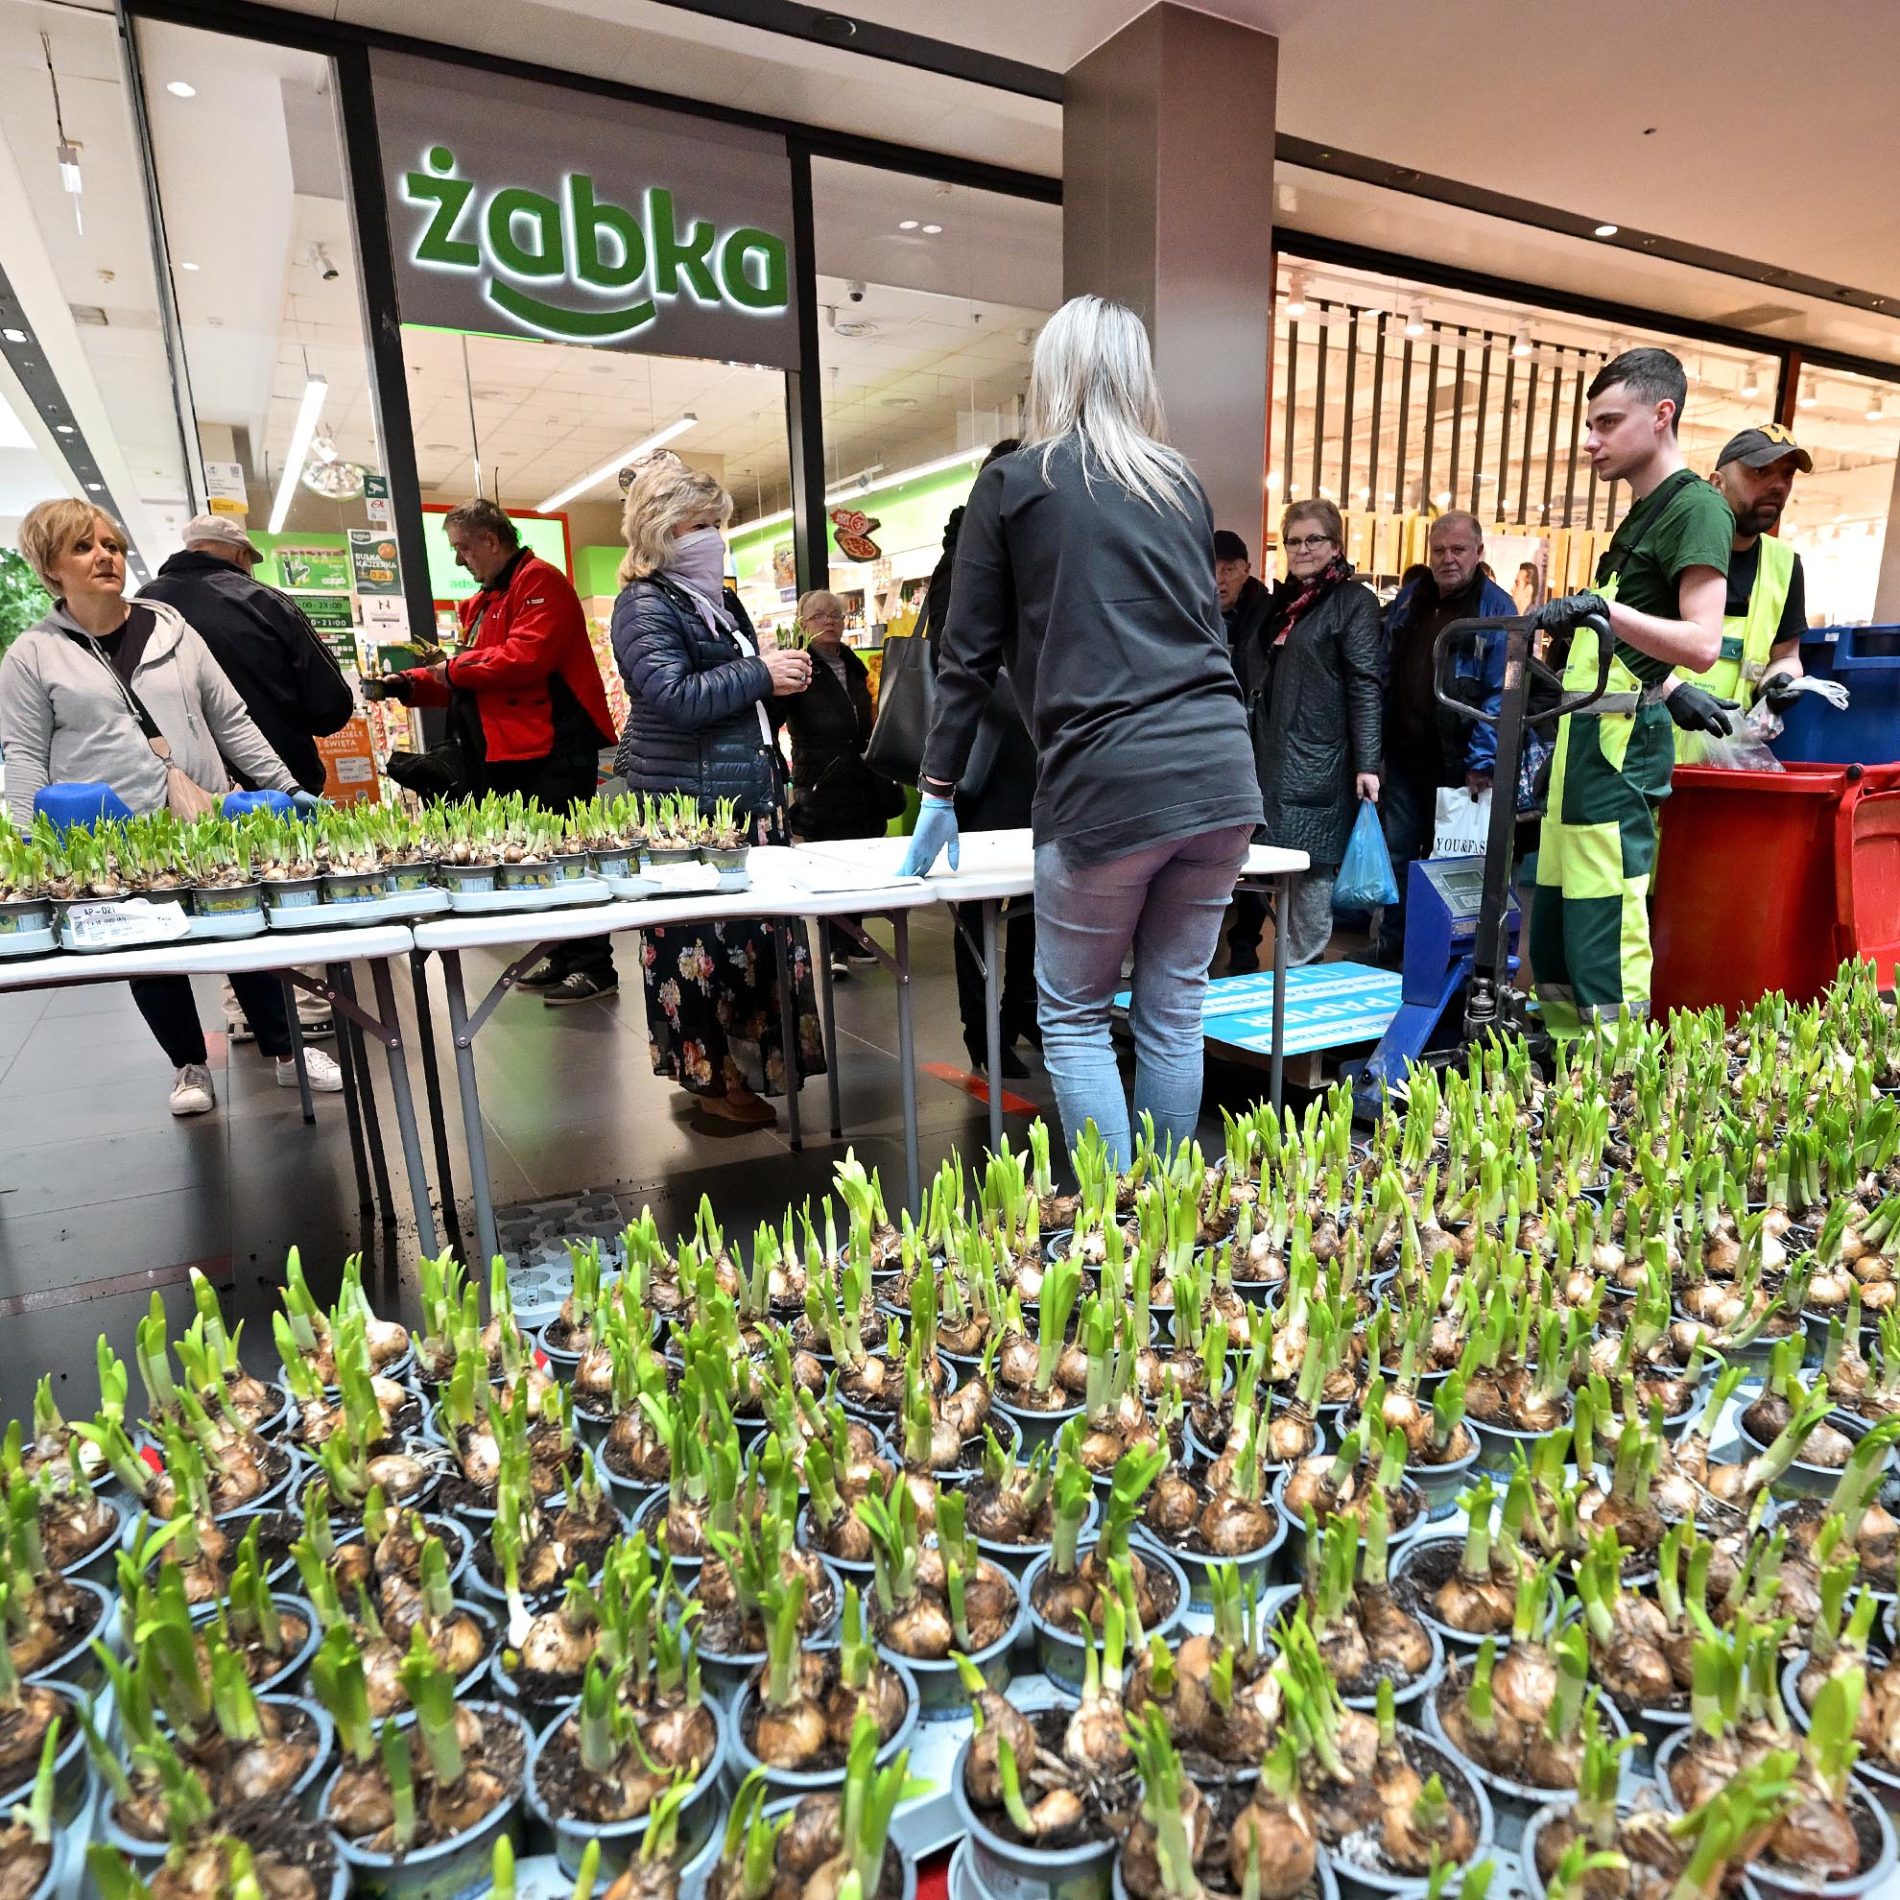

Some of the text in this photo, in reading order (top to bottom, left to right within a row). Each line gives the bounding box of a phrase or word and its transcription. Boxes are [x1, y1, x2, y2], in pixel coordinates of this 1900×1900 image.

[402, 145, 789, 310] żabka
[327, 730, 364, 739] EDZIELE
[1437, 837, 1486, 854] YOU&FAS
[1232, 996, 1400, 1028] PAPIER
